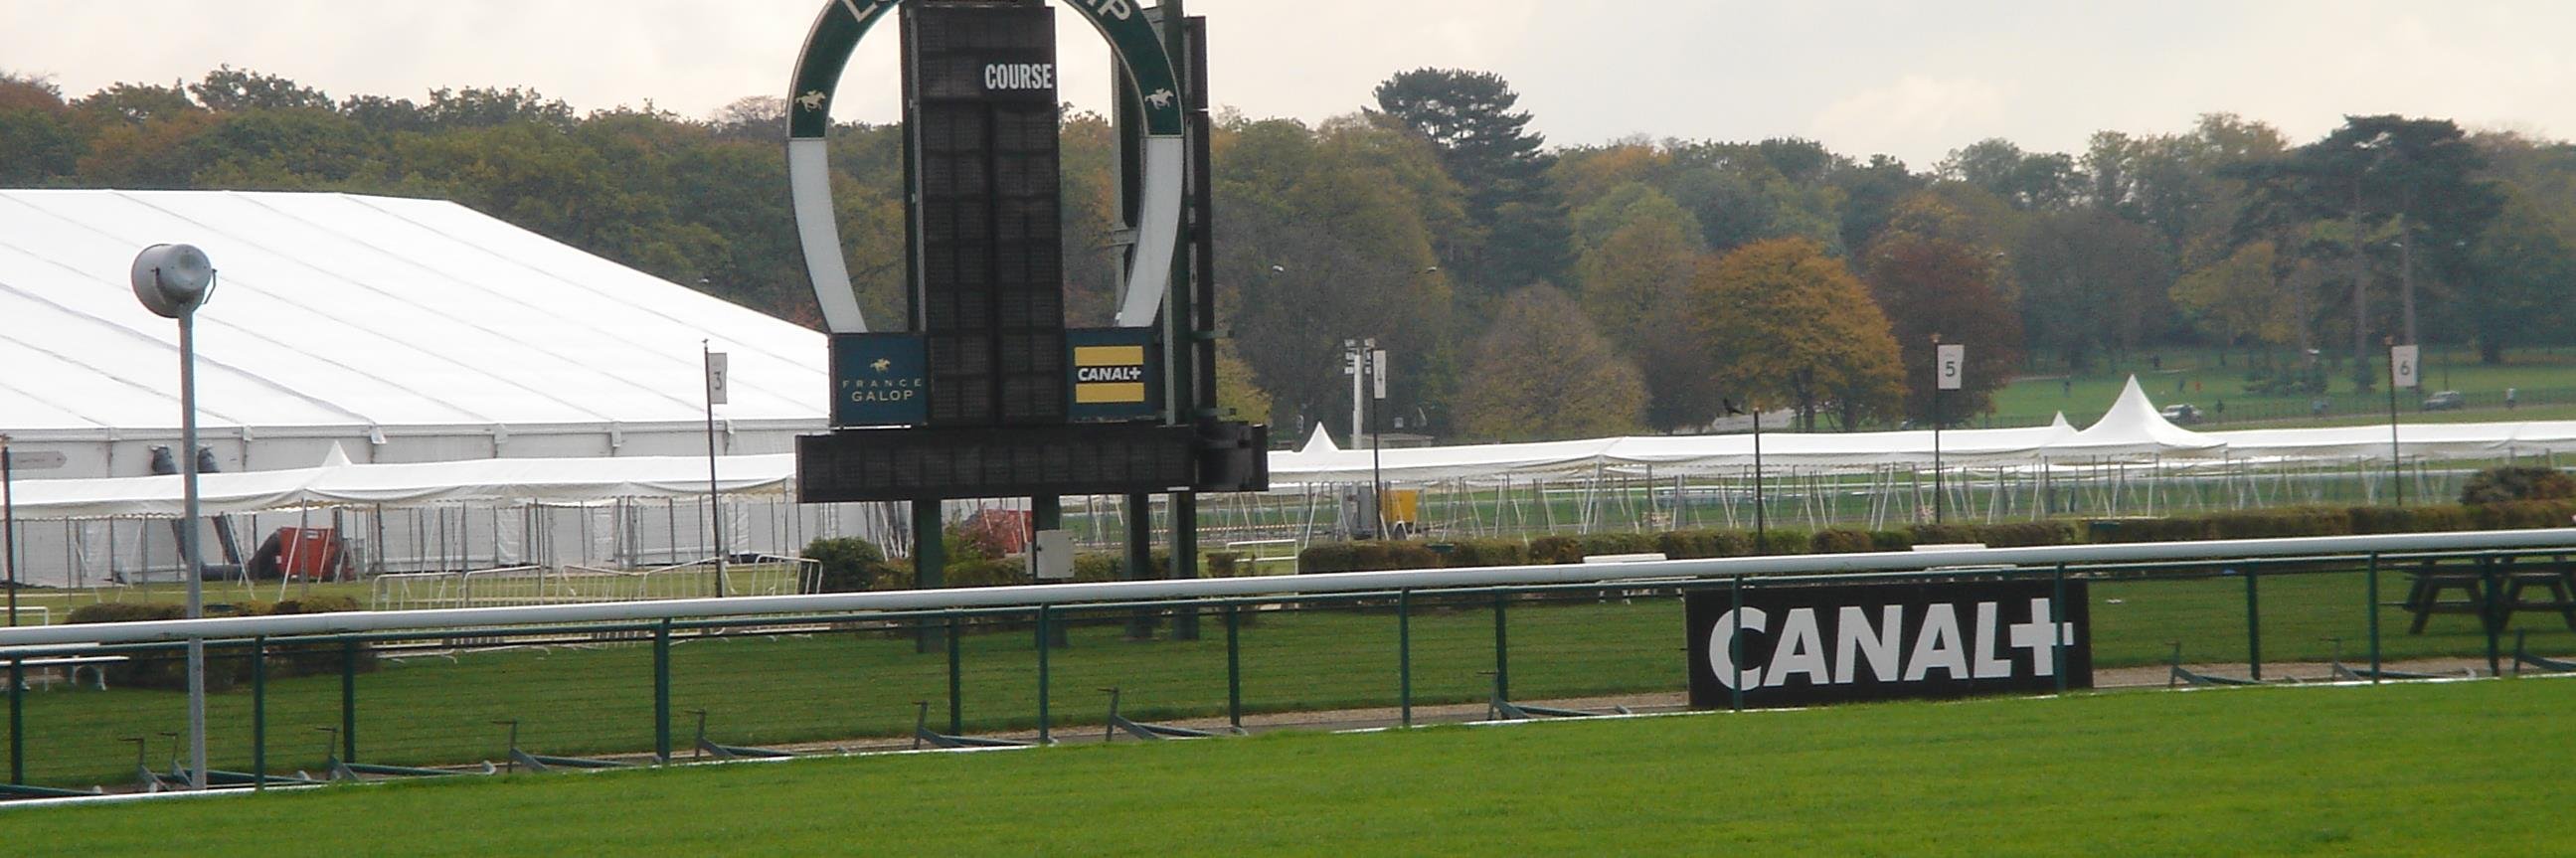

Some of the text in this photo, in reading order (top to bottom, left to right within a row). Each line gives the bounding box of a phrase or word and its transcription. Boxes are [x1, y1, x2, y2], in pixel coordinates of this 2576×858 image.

[985, 64, 1053, 89] COURSE
[1078, 366, 1141, 382] CANAL+
[1945, 361, 1956, 377] 5
[2400, 360, 2411, 376] 6
[713, 371, 723, 390] 3
[842, 379, 922, 389] FRANCE
[851, 390, 914, 402] GALOP
[1709, 598, 2074, 691] CANAL+
